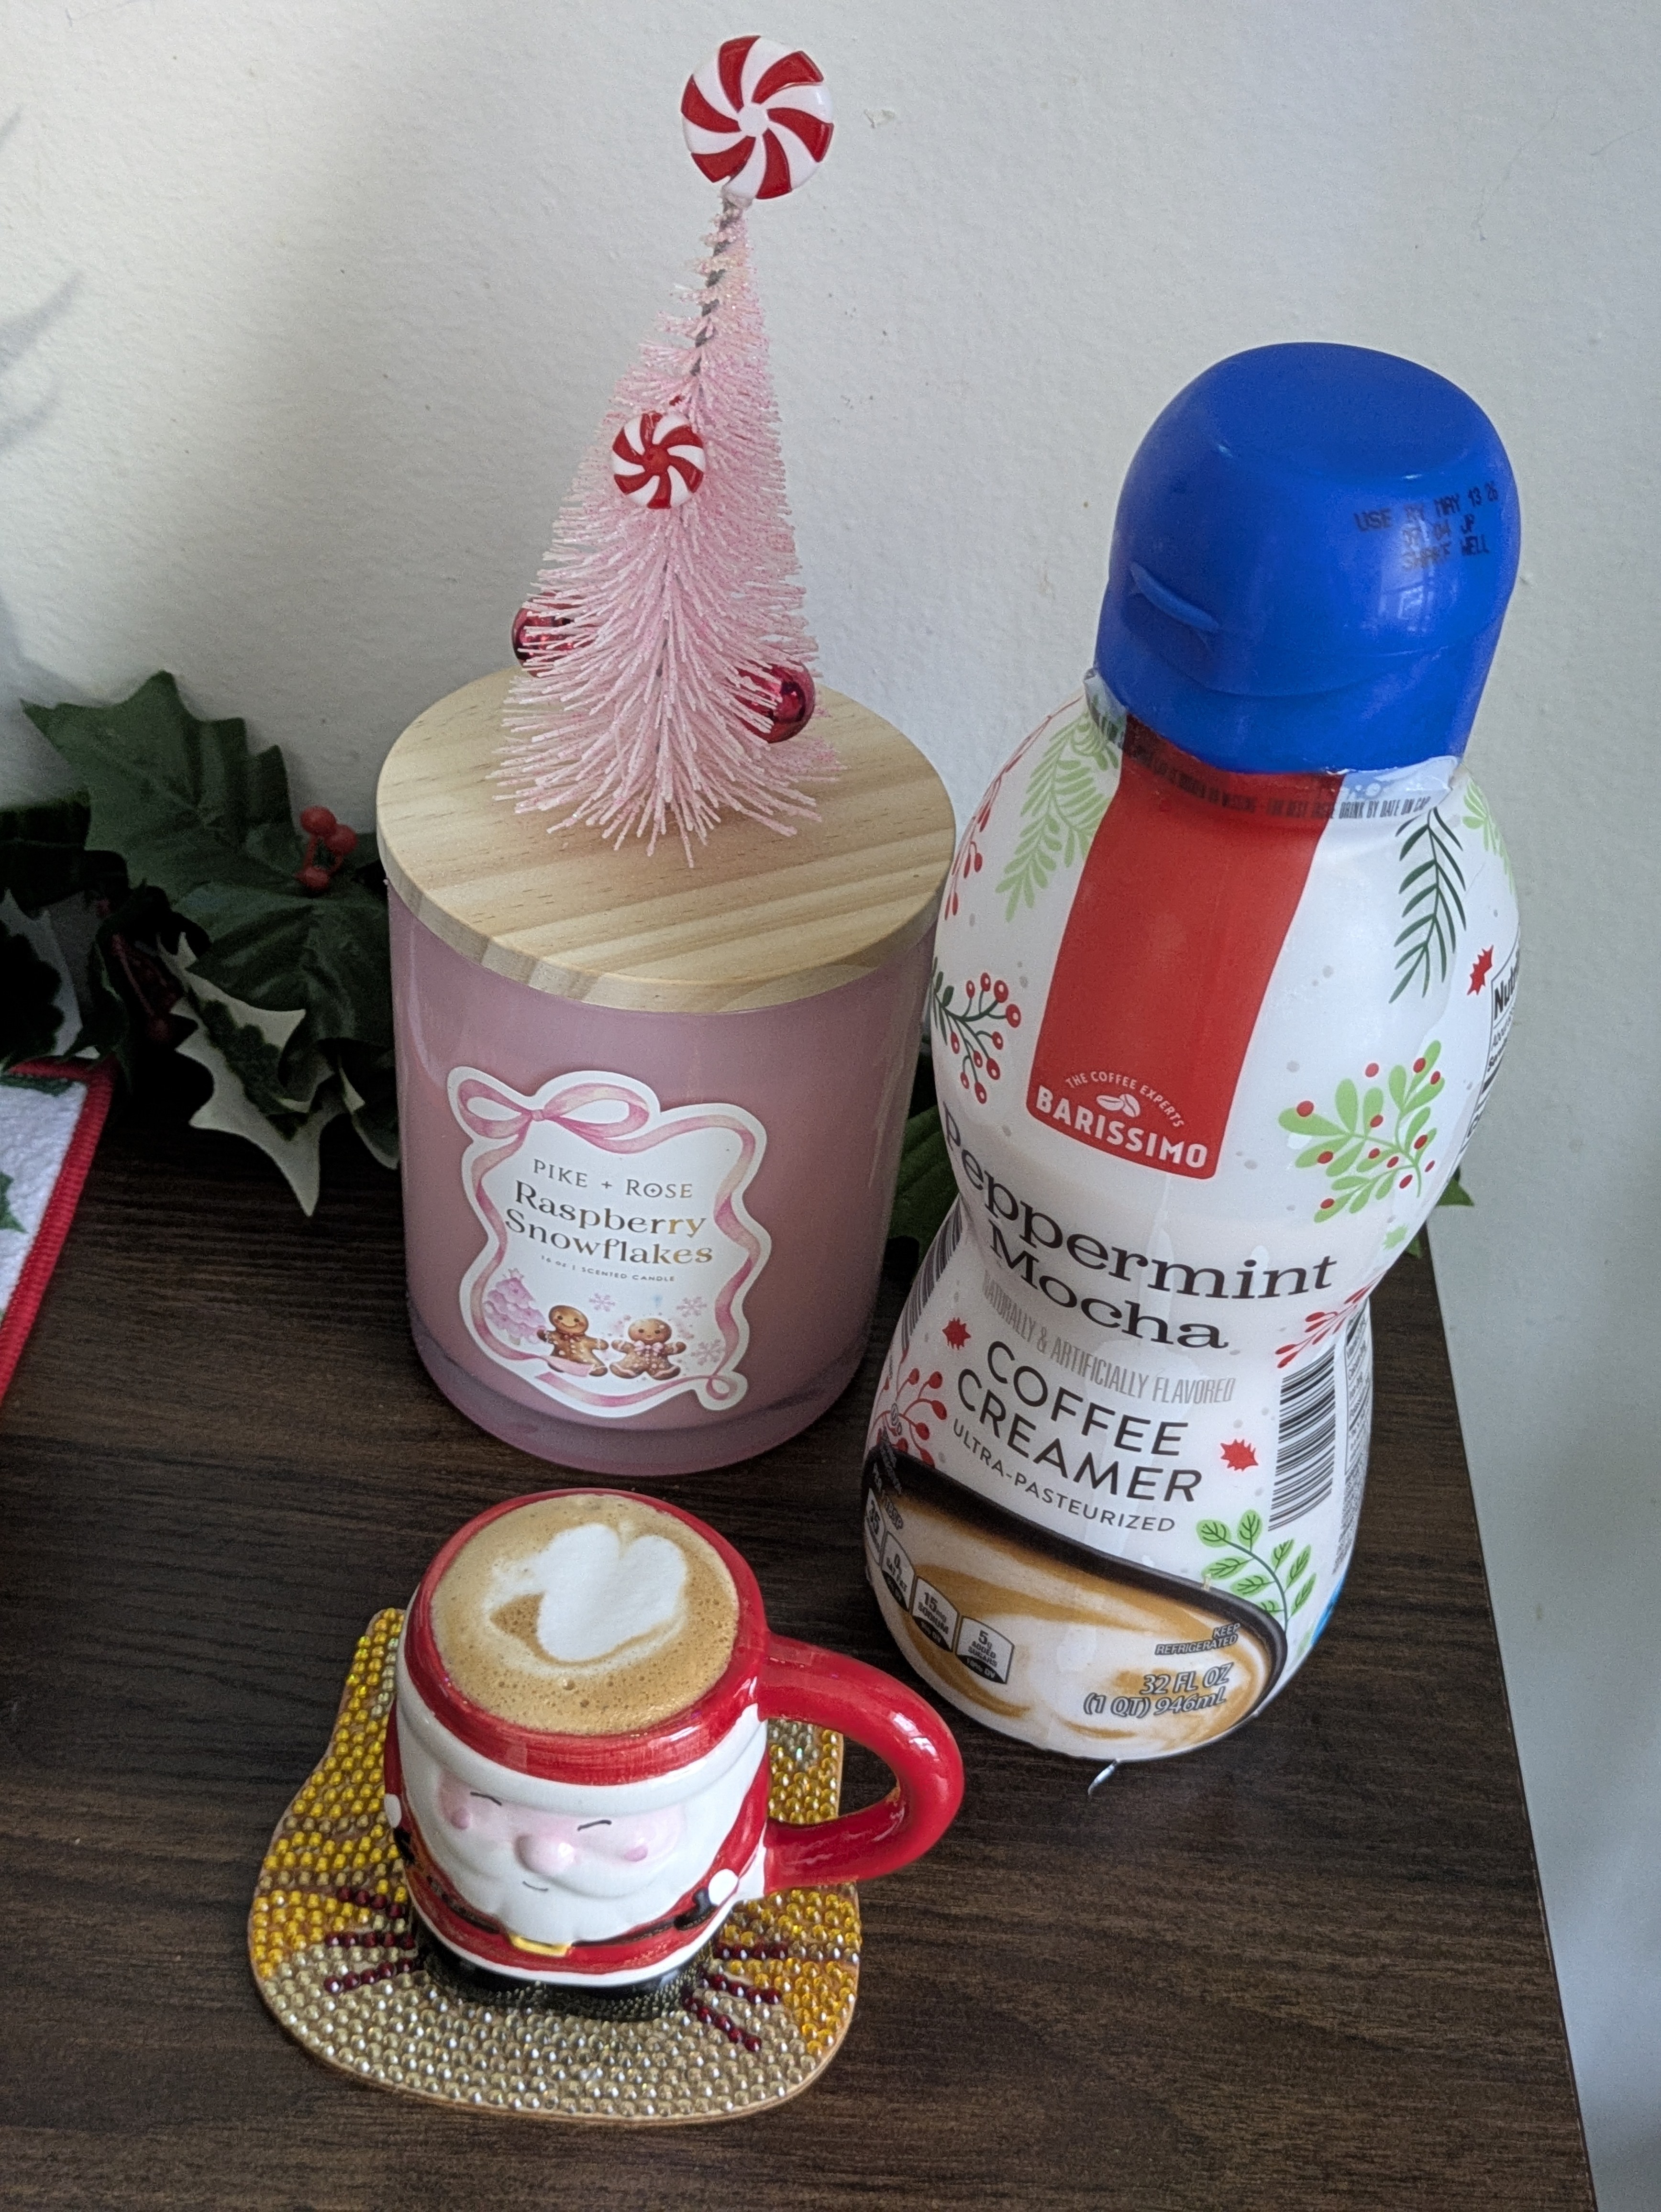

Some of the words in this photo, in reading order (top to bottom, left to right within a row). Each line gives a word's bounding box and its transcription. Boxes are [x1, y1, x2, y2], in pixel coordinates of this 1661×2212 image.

[1339, 801, 1365, 819] DRINK
[1367, 800, 1379, 818] BY
[1380, 799, 1400, 818] DATE
[1400, 797, 1415, 815] ON
[1413, 796, 1431, 812] CAP
[1065, 1073, 1088, 1088] THE
[1091, 1071, 1137, 1090] COFFEE
[1140, 1084, 1184, 1128] EXPERTS
[1036, 1085, 1207, 1168] BARISSIMO
[533, 1159, 588, 1188] PIKE
[601, 1180, 612, 1190] +
[626, 1179, 693, 1199] ROSE
[515, 1180, 707, 1239] Raspberry
[505, 1208, 713, 1264] Snowflakes
[582, 1267, 628, 1279] SCENTED
[988, 1219, 1229, 1349] Mocha
[1037, 1327, 1048, 1354] &
[1051, 1337, 1149, 1400] ARTIFICIALLY
[1152, 1376, 1236, 1405] FLAVORED
[986, 1340, 1188, 1456] COFFEE
[958, 1368, 1202, 1502] CREAMER
[952, 1417, 1175, 1532] ULTRA-PASTEURIZED
[918, 1602, 949, 1634] SODIUM
[1213, 1623, 1241, 1639] KEEP
[968, 1646, 998, 1668] SUGARS
[972, 1640, 997, 1659] ADDED
[978, 1629, 992, 1649] 5g
[1154, 1633, 1239, 1655] REFRIGERATED
[1139, 1673, 1172, 1695] 32
[1172, 1670, 1198, 1693] FL
[1202, 1662, 1234, 1689] OZ
[1083, 1692, 1107, 1715] (1
[1110, 1696, 1151, 1719] QT)
[1153, 1686, 1227, 1716] 946mL
